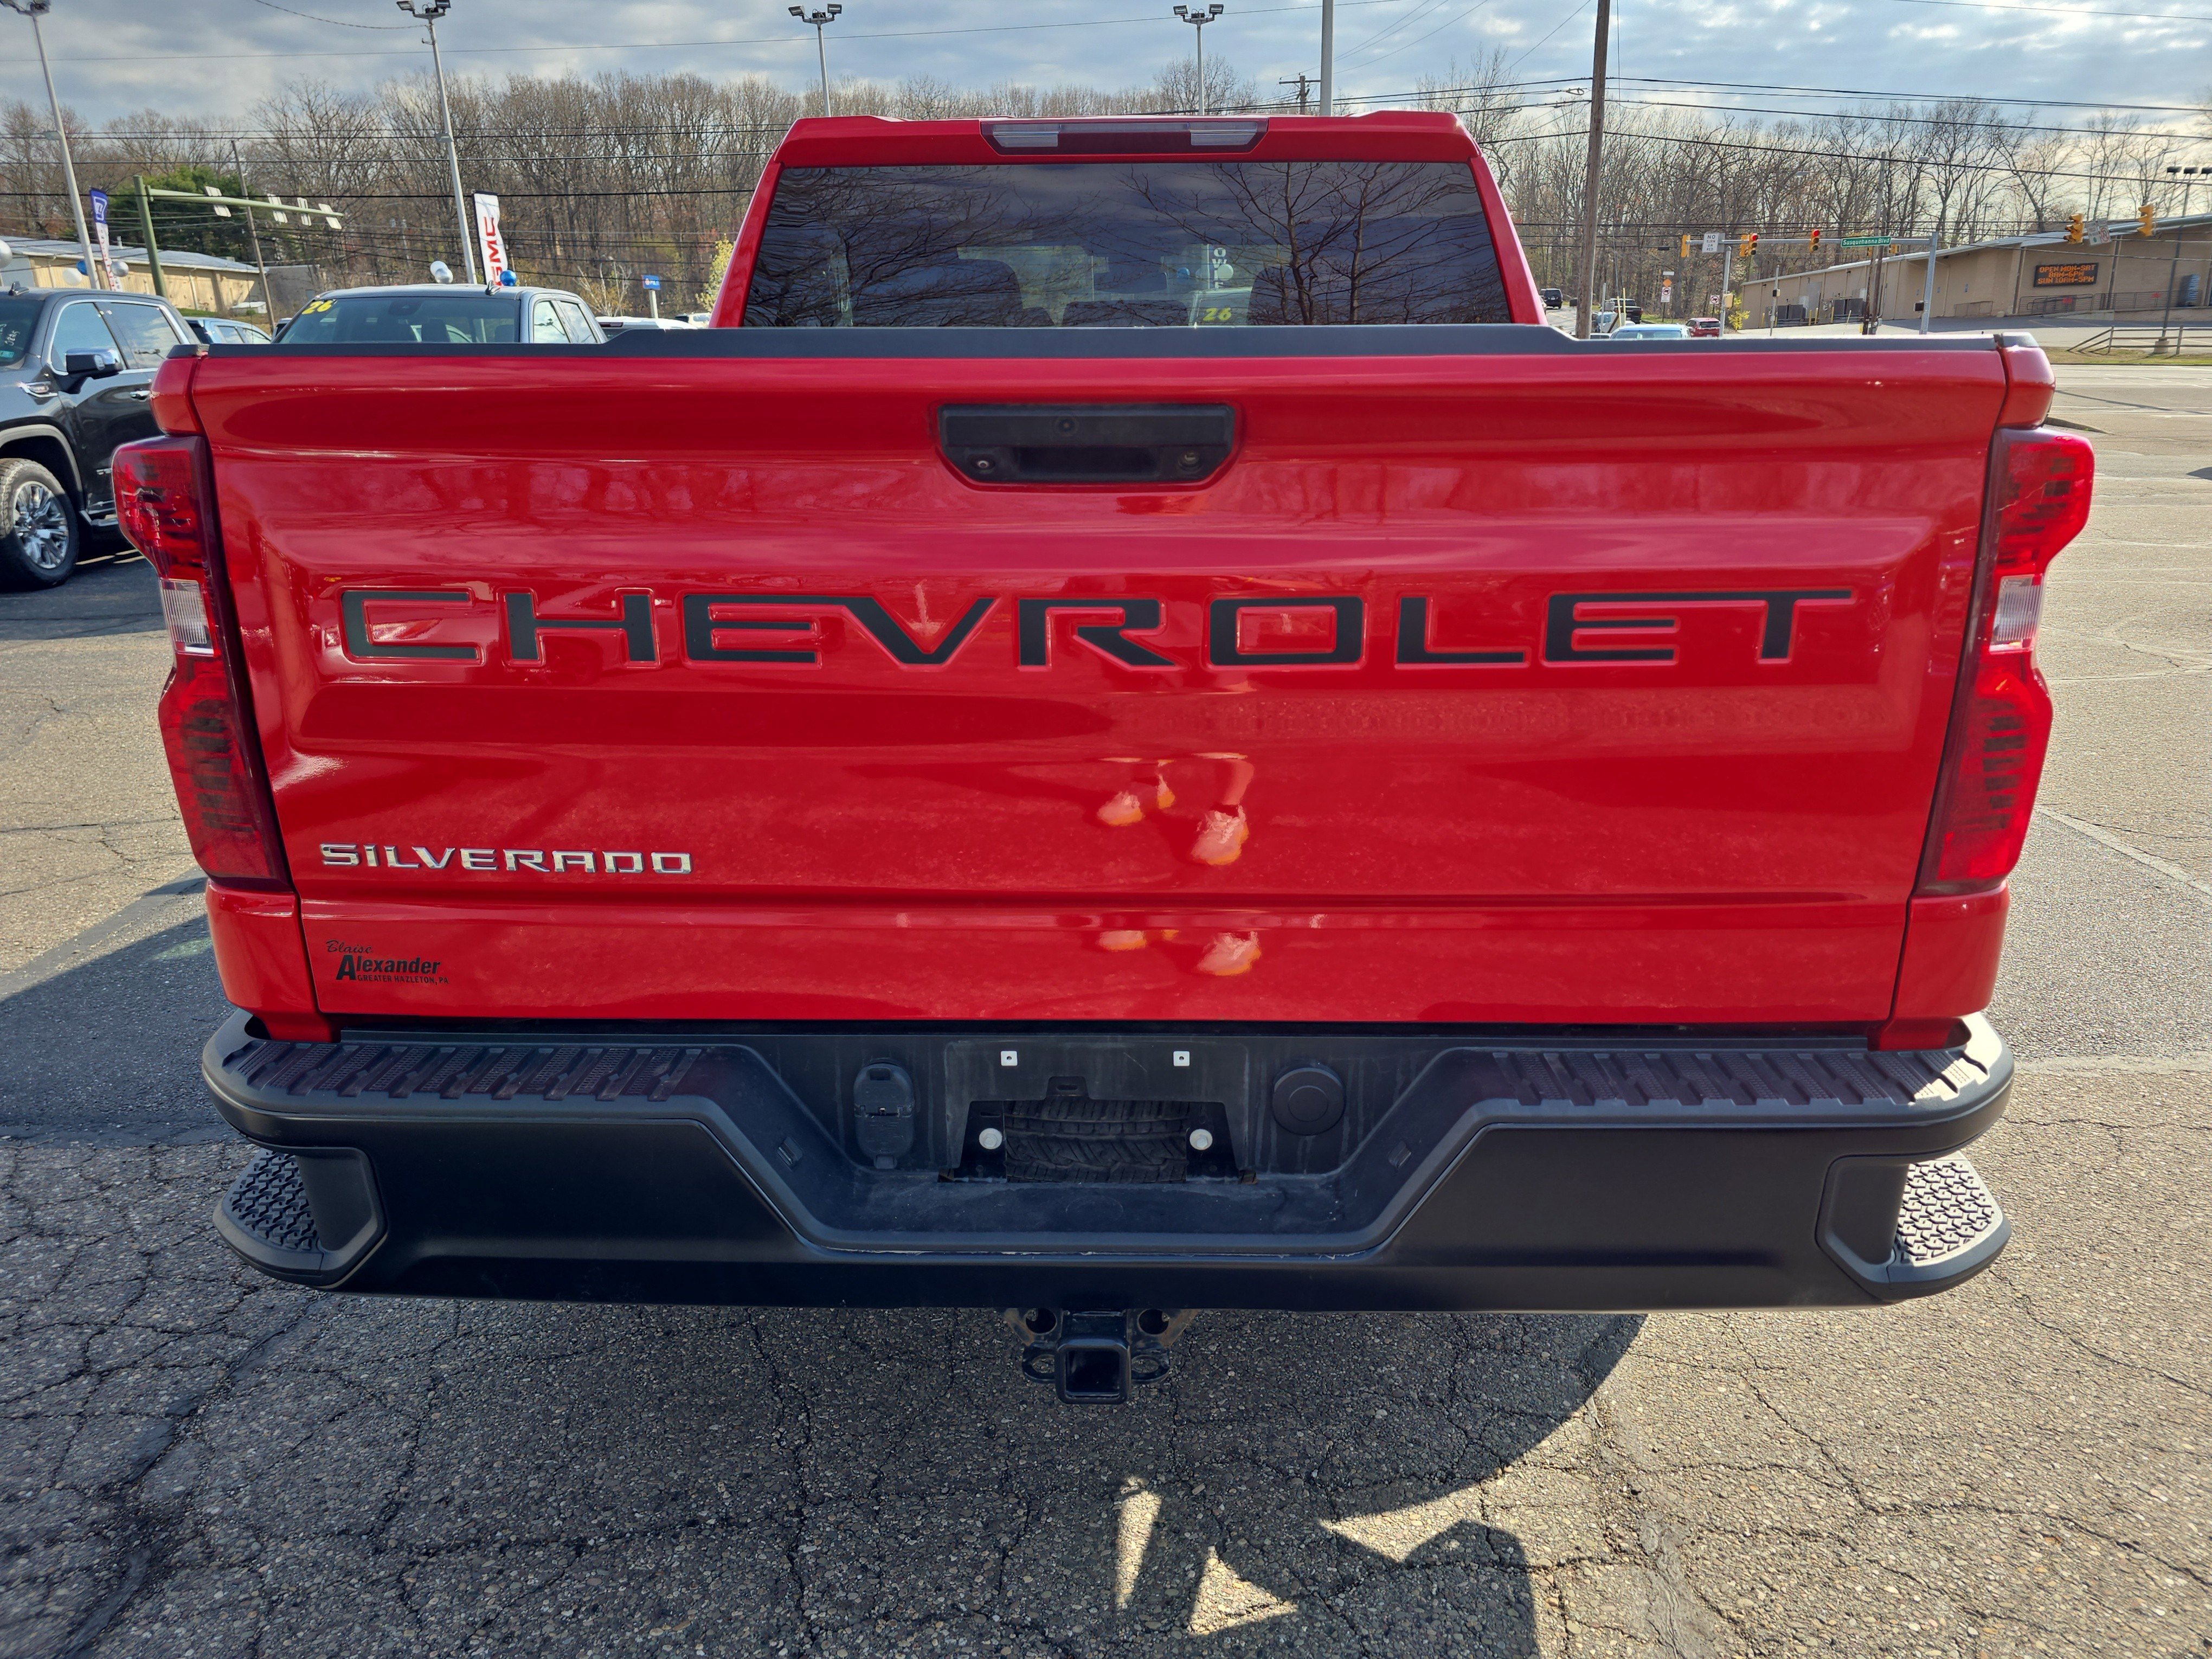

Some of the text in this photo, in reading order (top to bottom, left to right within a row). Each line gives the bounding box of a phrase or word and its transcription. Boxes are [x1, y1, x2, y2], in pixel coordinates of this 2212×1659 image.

[301, 300, 333, 314] 26
[1203, 307, 1232, 321] 26
[339, 589, 1854, 669] CHEVROLET
[320, 843, 693, 874] SILVERADO
[325, 940, 374, 954] Blaise
[335, 954, 442, 980] Alexander
[358, 974, 392, 982] GREATER
[394, 975, 438, 986] HAZLETON,
